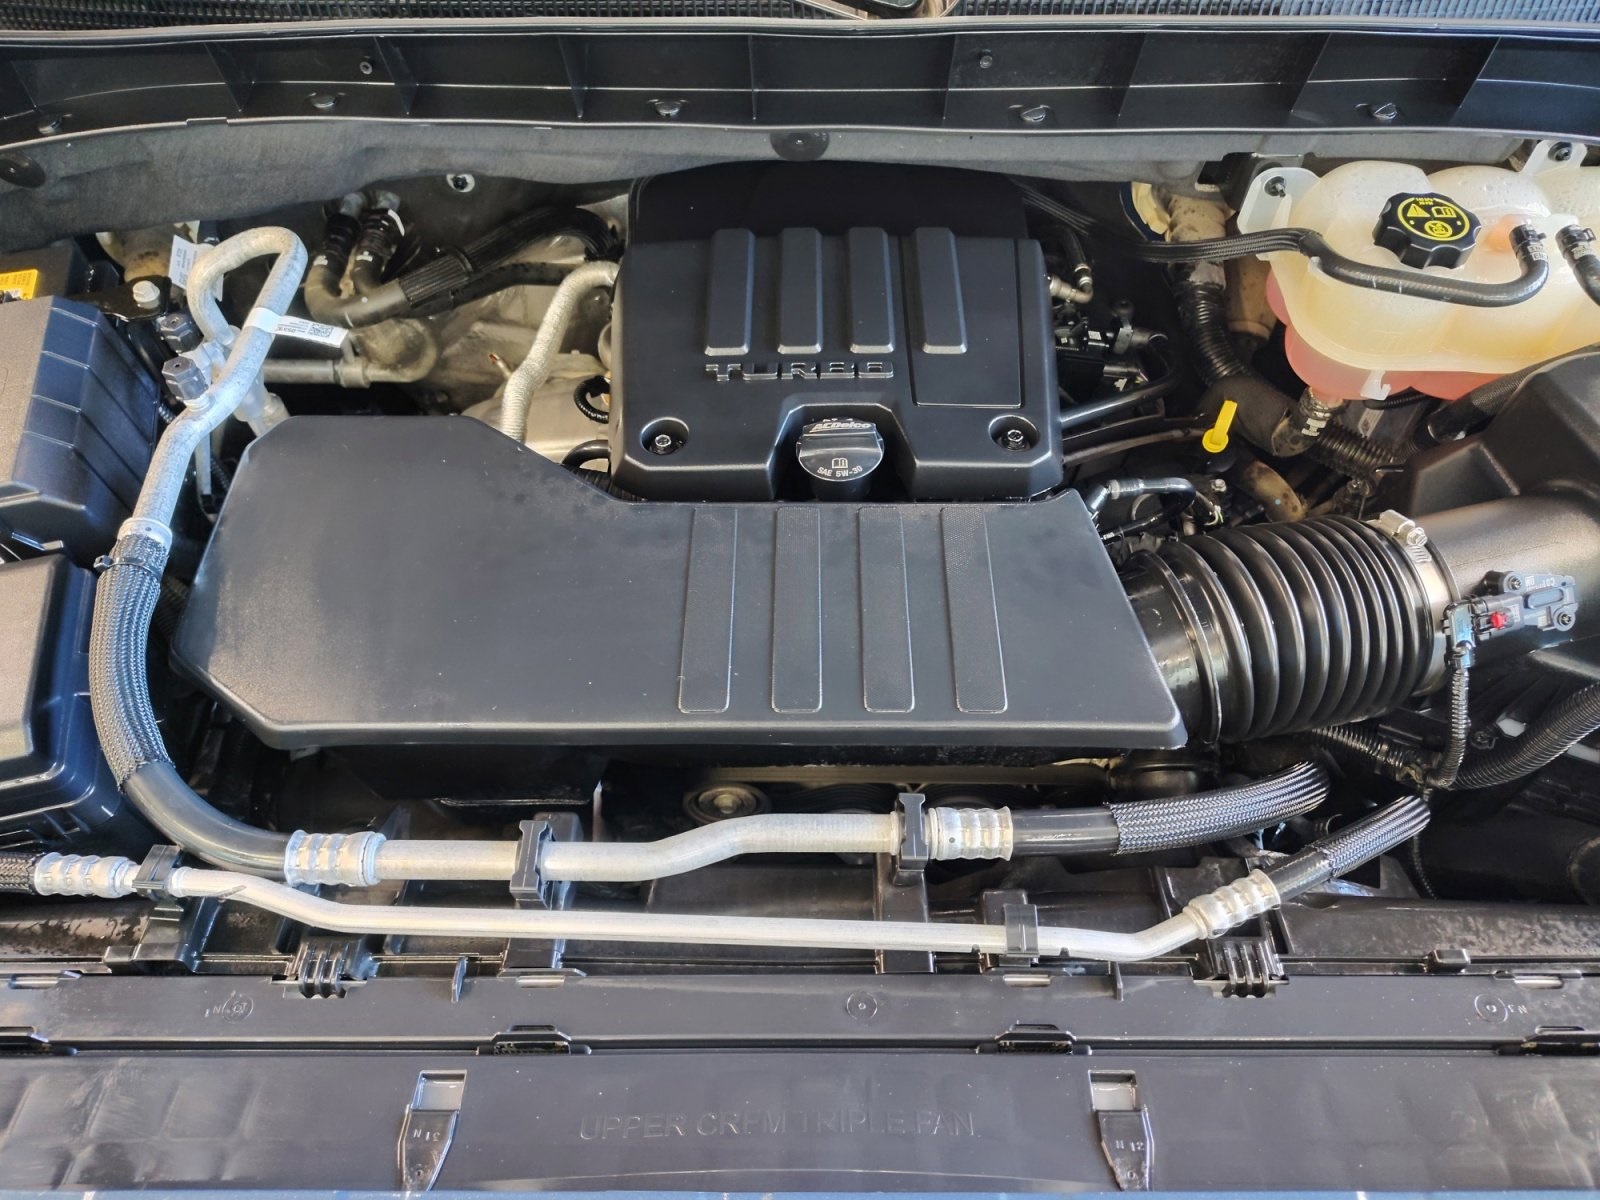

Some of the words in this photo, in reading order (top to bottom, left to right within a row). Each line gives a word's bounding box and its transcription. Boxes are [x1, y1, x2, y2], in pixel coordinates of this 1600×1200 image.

[705, 361, 894, 382] TURBO
[809, 420, 872, 433] ACDelco
[816, 466, 833, 477] SAE
[835, 465, 863, 478] 5W-30
[579, 1111, 685, 1140] UPPER
[798, 1108, 907, 1136] TRIPLE
[915, 1110, 975, 1137] FAN
